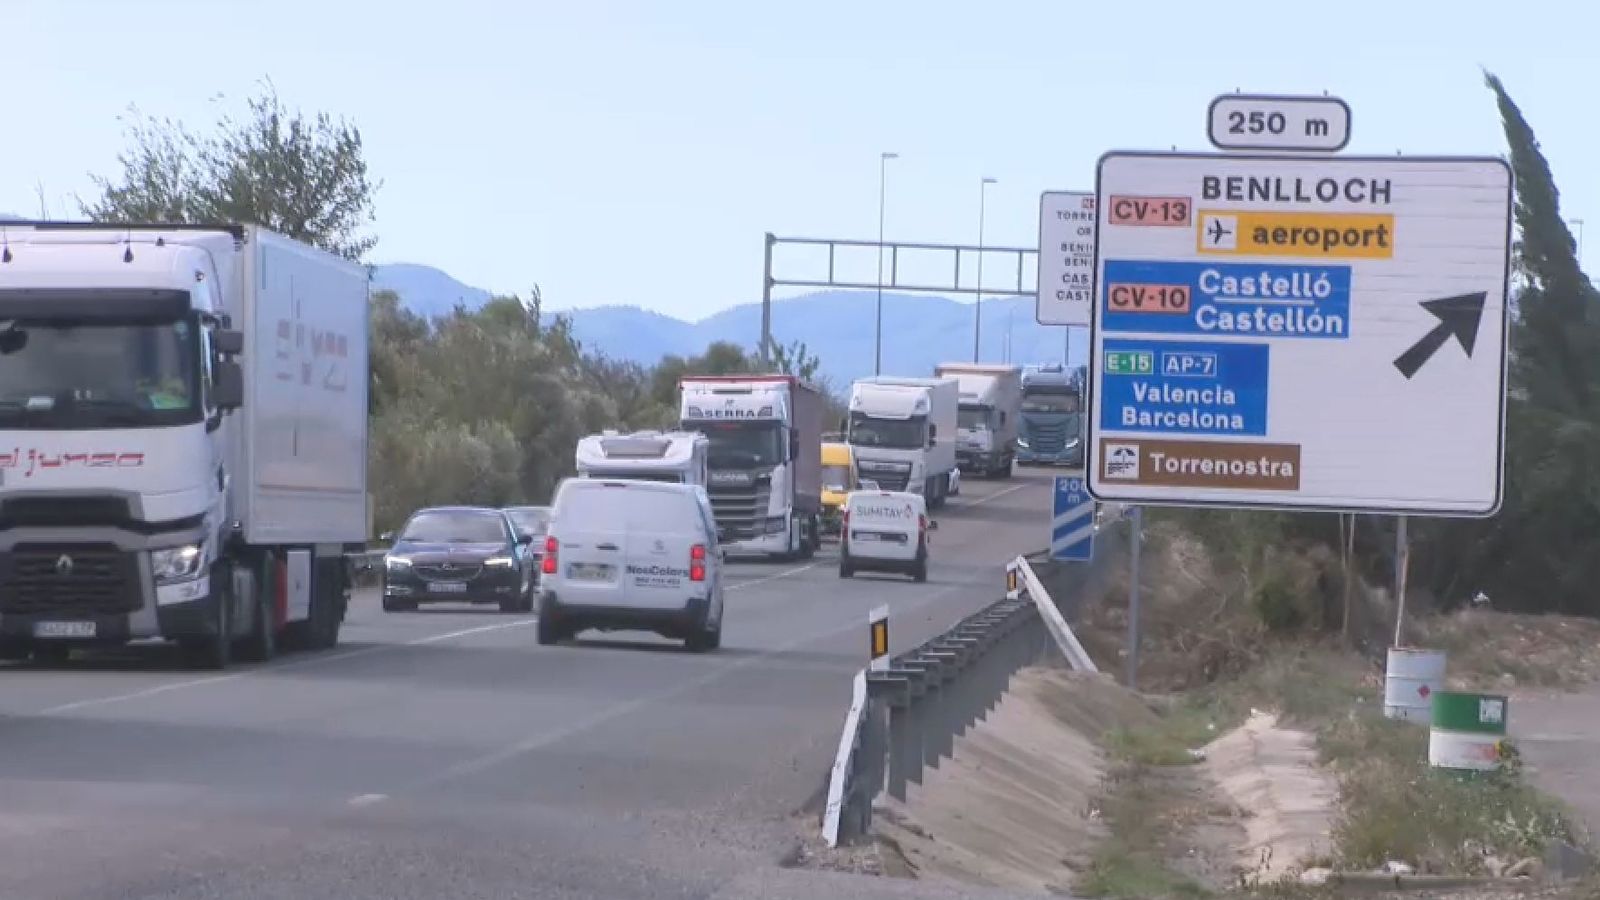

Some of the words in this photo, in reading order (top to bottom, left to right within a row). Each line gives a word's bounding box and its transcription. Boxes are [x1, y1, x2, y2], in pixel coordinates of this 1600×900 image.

[1228, 111, 1286, 135] 250
[1304, 117, 1329, 136] m
[1202, 176, 1392, 204] BENLLOCH
[1114, 199, 1187, 222] CV-13
[1252, 223, 1390, 251] aeroport
[1199, 269, 1332, 298] Castelló
[1110, 286, 1187, 308] CV-10
[1195, 304, 1344, 335] Castellón
[1107, 354, 1150, 371] E-15
[1166, 356, 1214, 374] AP-7
[1132, 381, 1236, 405] Valencia
[1122, 406, 1245, 430] Barcelona
[1149, 453, 1294, 478] Torrenostra
